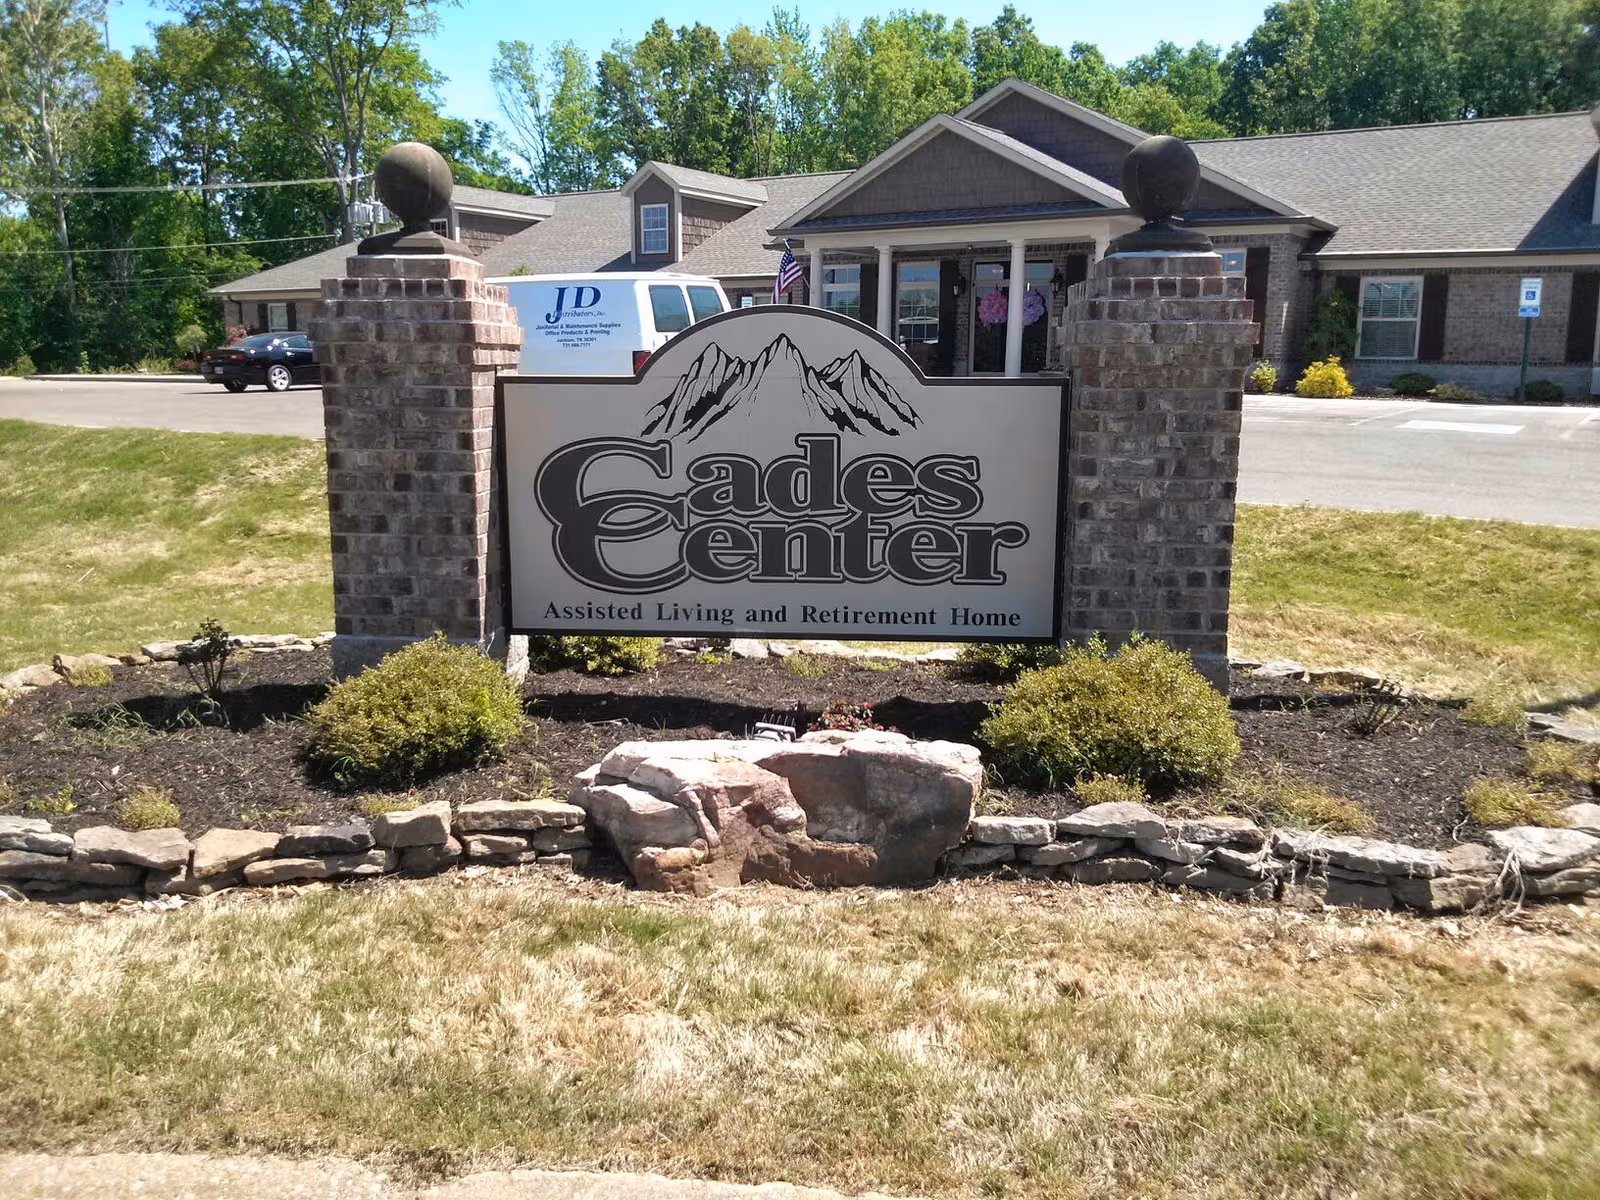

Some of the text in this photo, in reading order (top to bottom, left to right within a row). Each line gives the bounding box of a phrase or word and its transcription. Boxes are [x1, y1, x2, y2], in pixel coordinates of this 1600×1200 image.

[545, 286, 602, 324] JD
[534, 433, 984, 521] Cades
[552, 497, 1030, 594] Center
[544, 601, 1022, 627] Assisted Living and Retirement Home
